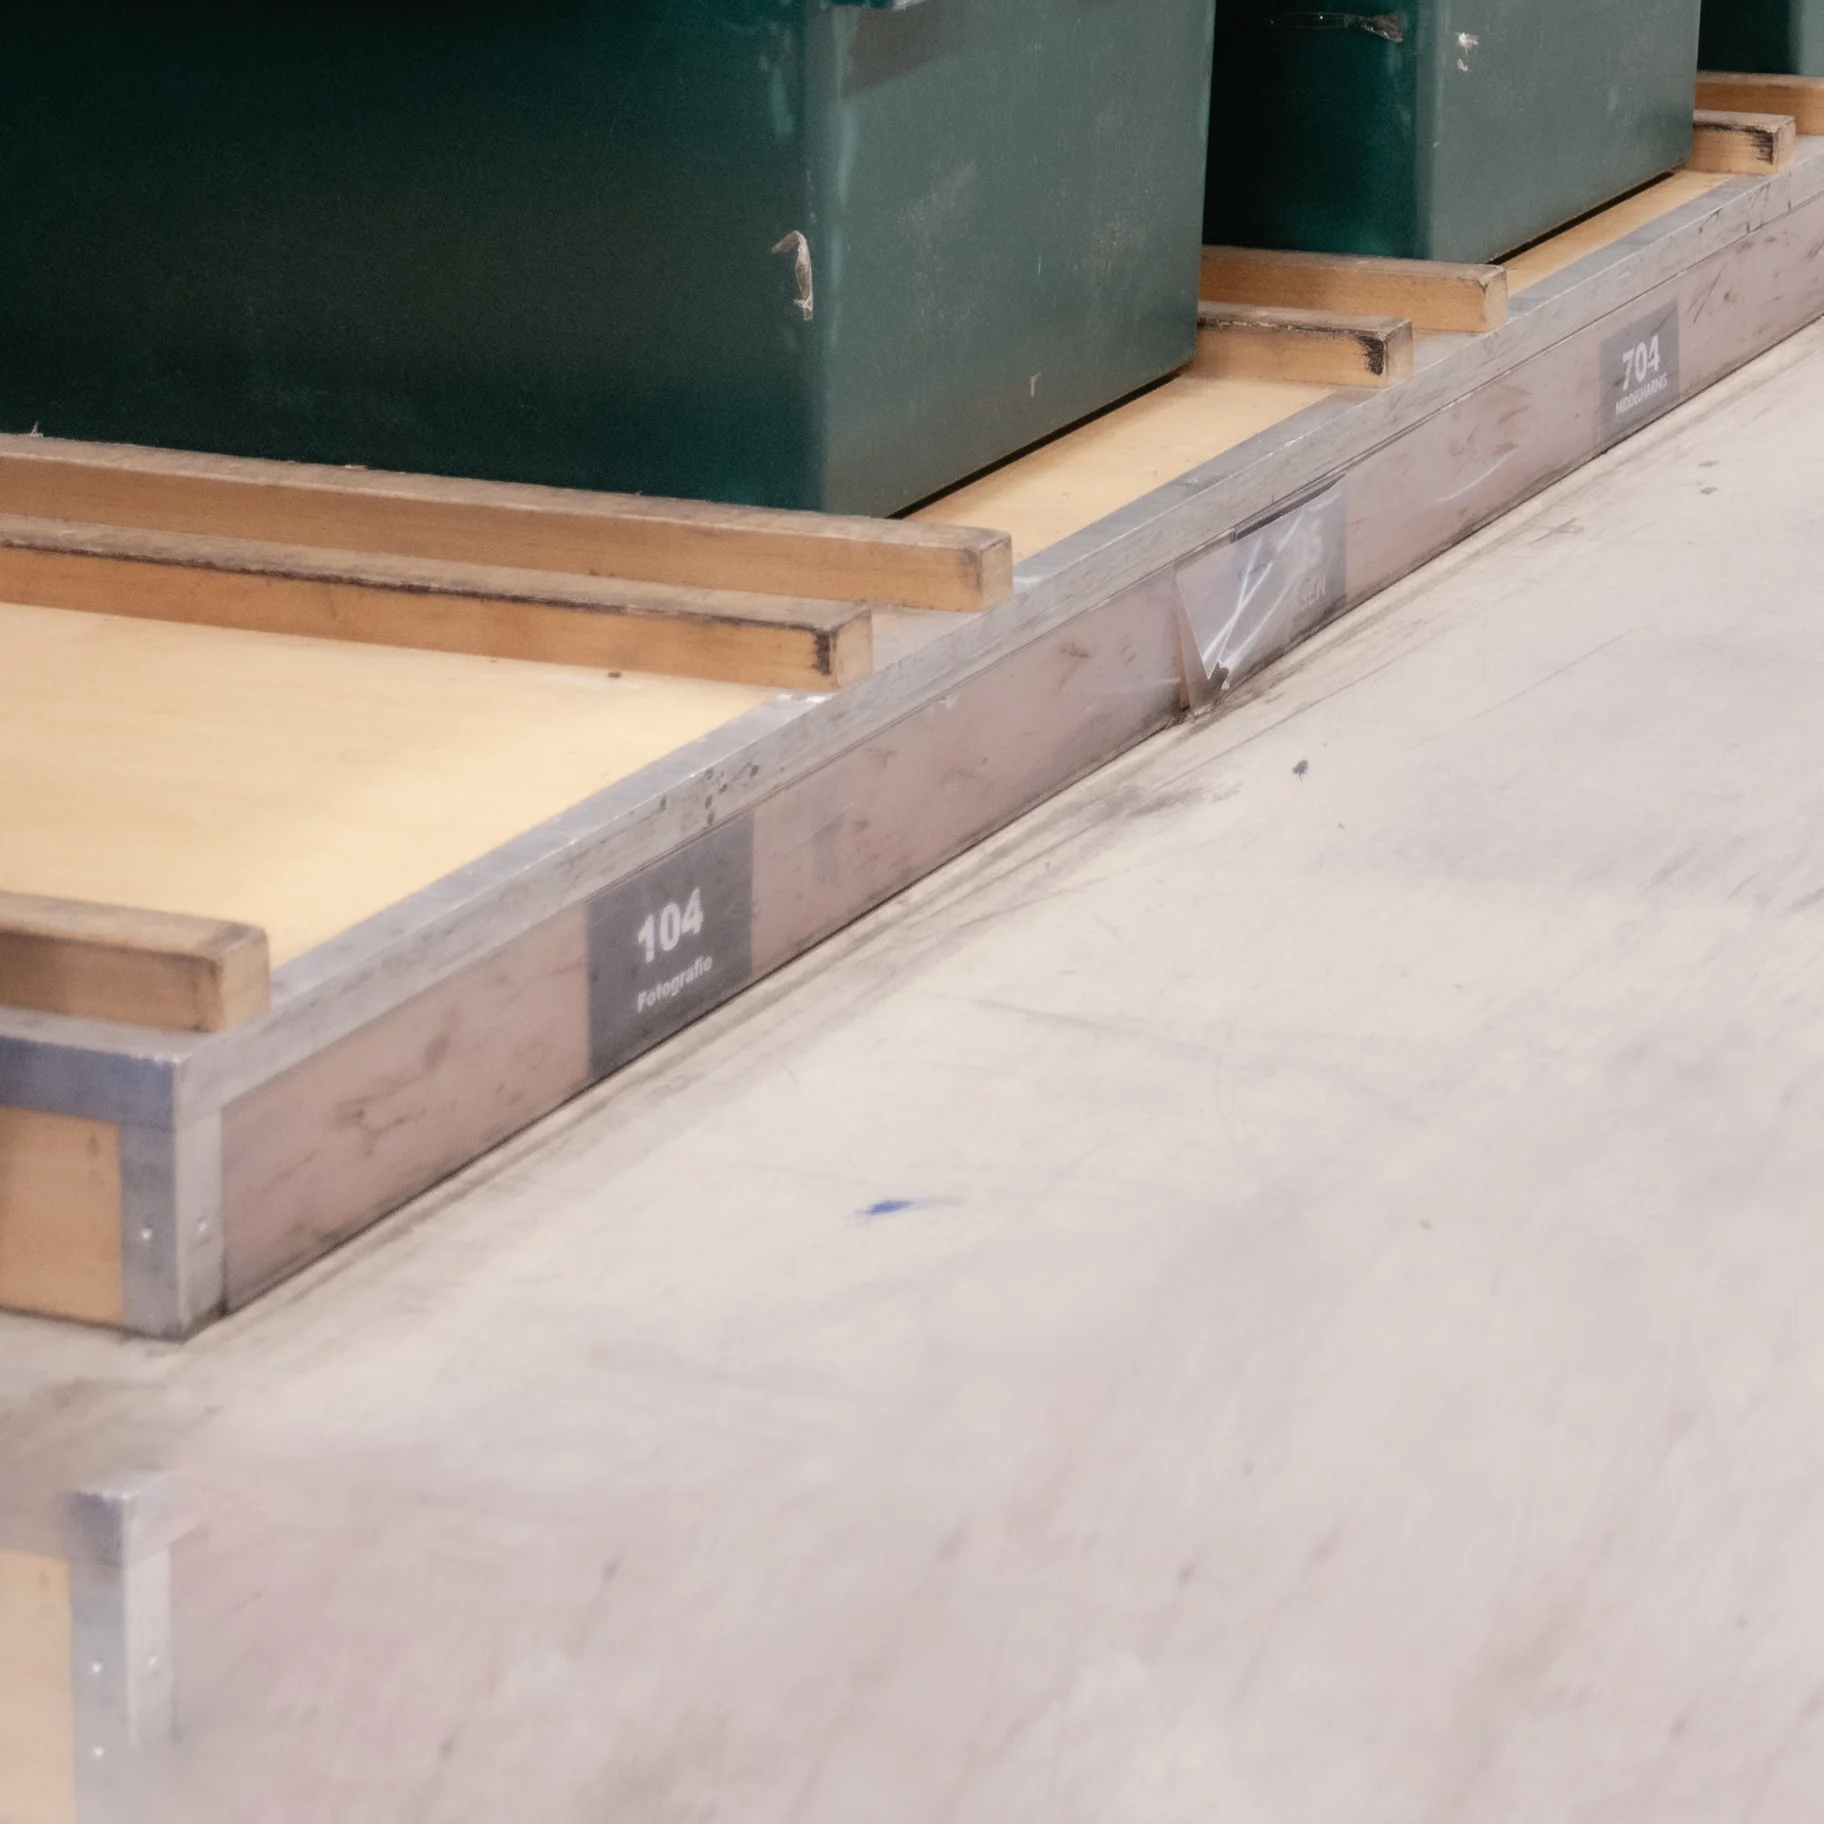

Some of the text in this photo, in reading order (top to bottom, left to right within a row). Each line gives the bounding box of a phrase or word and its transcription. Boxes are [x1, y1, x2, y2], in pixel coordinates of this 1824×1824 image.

[1622, 334, 1660, 391] 704
[637, 887, 704, 963] 104
[636, 956, 713, 1013] Fotografie
